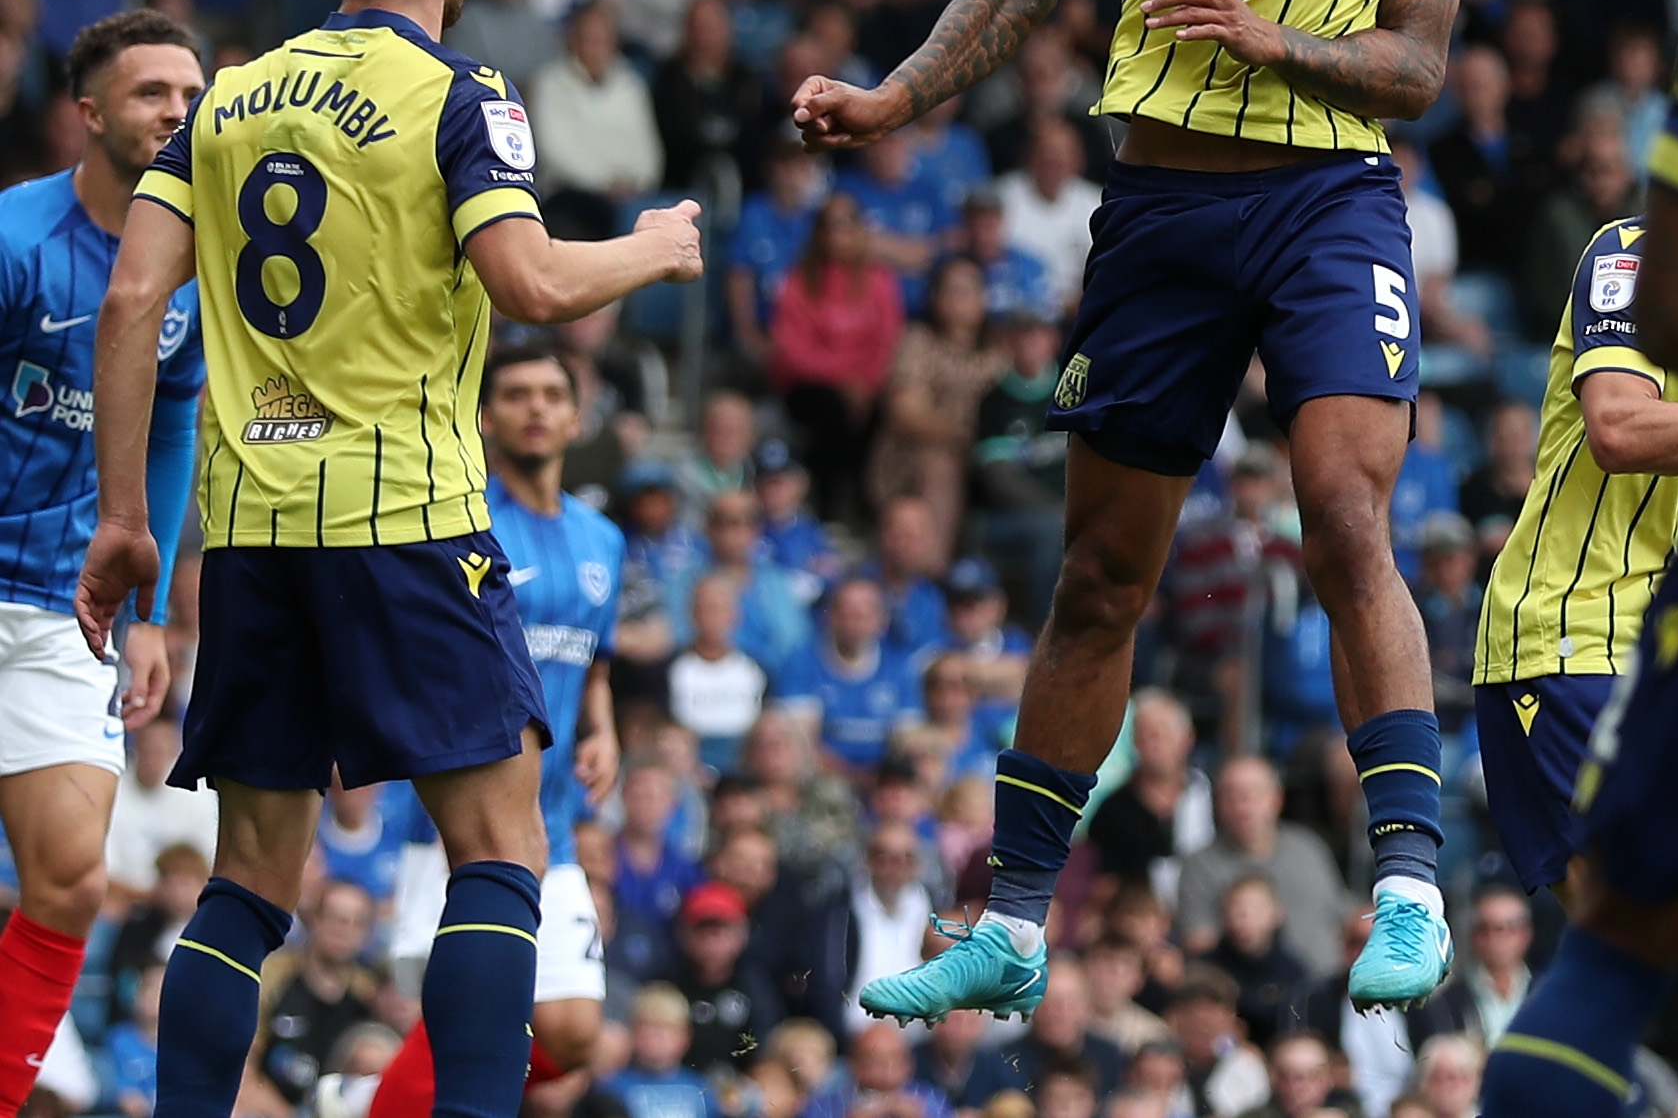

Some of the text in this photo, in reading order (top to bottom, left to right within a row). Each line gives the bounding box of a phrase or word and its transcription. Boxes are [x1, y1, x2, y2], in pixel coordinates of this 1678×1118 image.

[214, 70, 397, 148] MOLUMBY
[236, 152, 328, 340] 8
[1371, 263, 1410, 340] 5
[249, 423, 321, 440] RICHES
[258, 395, 325, 418] MEGA
